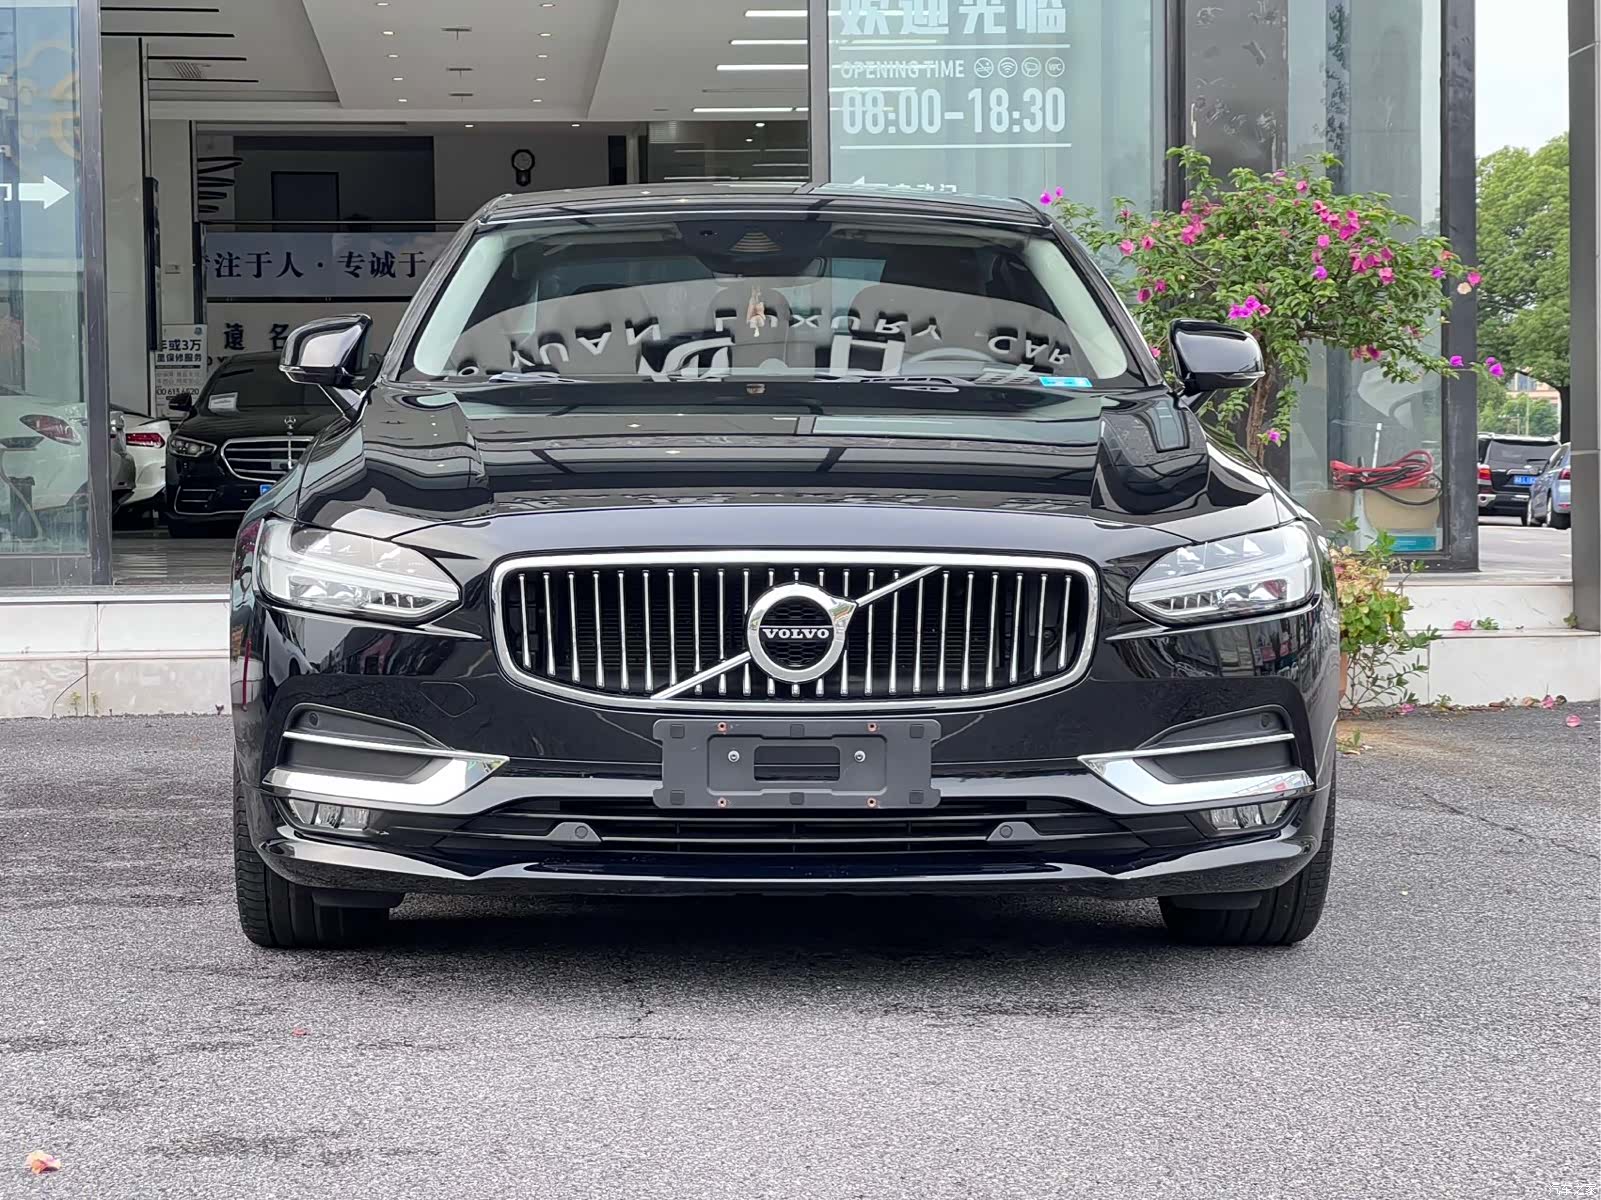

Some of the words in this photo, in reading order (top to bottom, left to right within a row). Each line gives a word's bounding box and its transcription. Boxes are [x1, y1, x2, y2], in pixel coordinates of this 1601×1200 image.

[841, 60, 919, 78] OPENING
[926, 60, 965, 78] TIME
[843, 87, 1066, 134] 08:00-18:30
[204, 251, 434, 279] 注于人·专诚于
[762, 628, 830, 639] VOLVO
